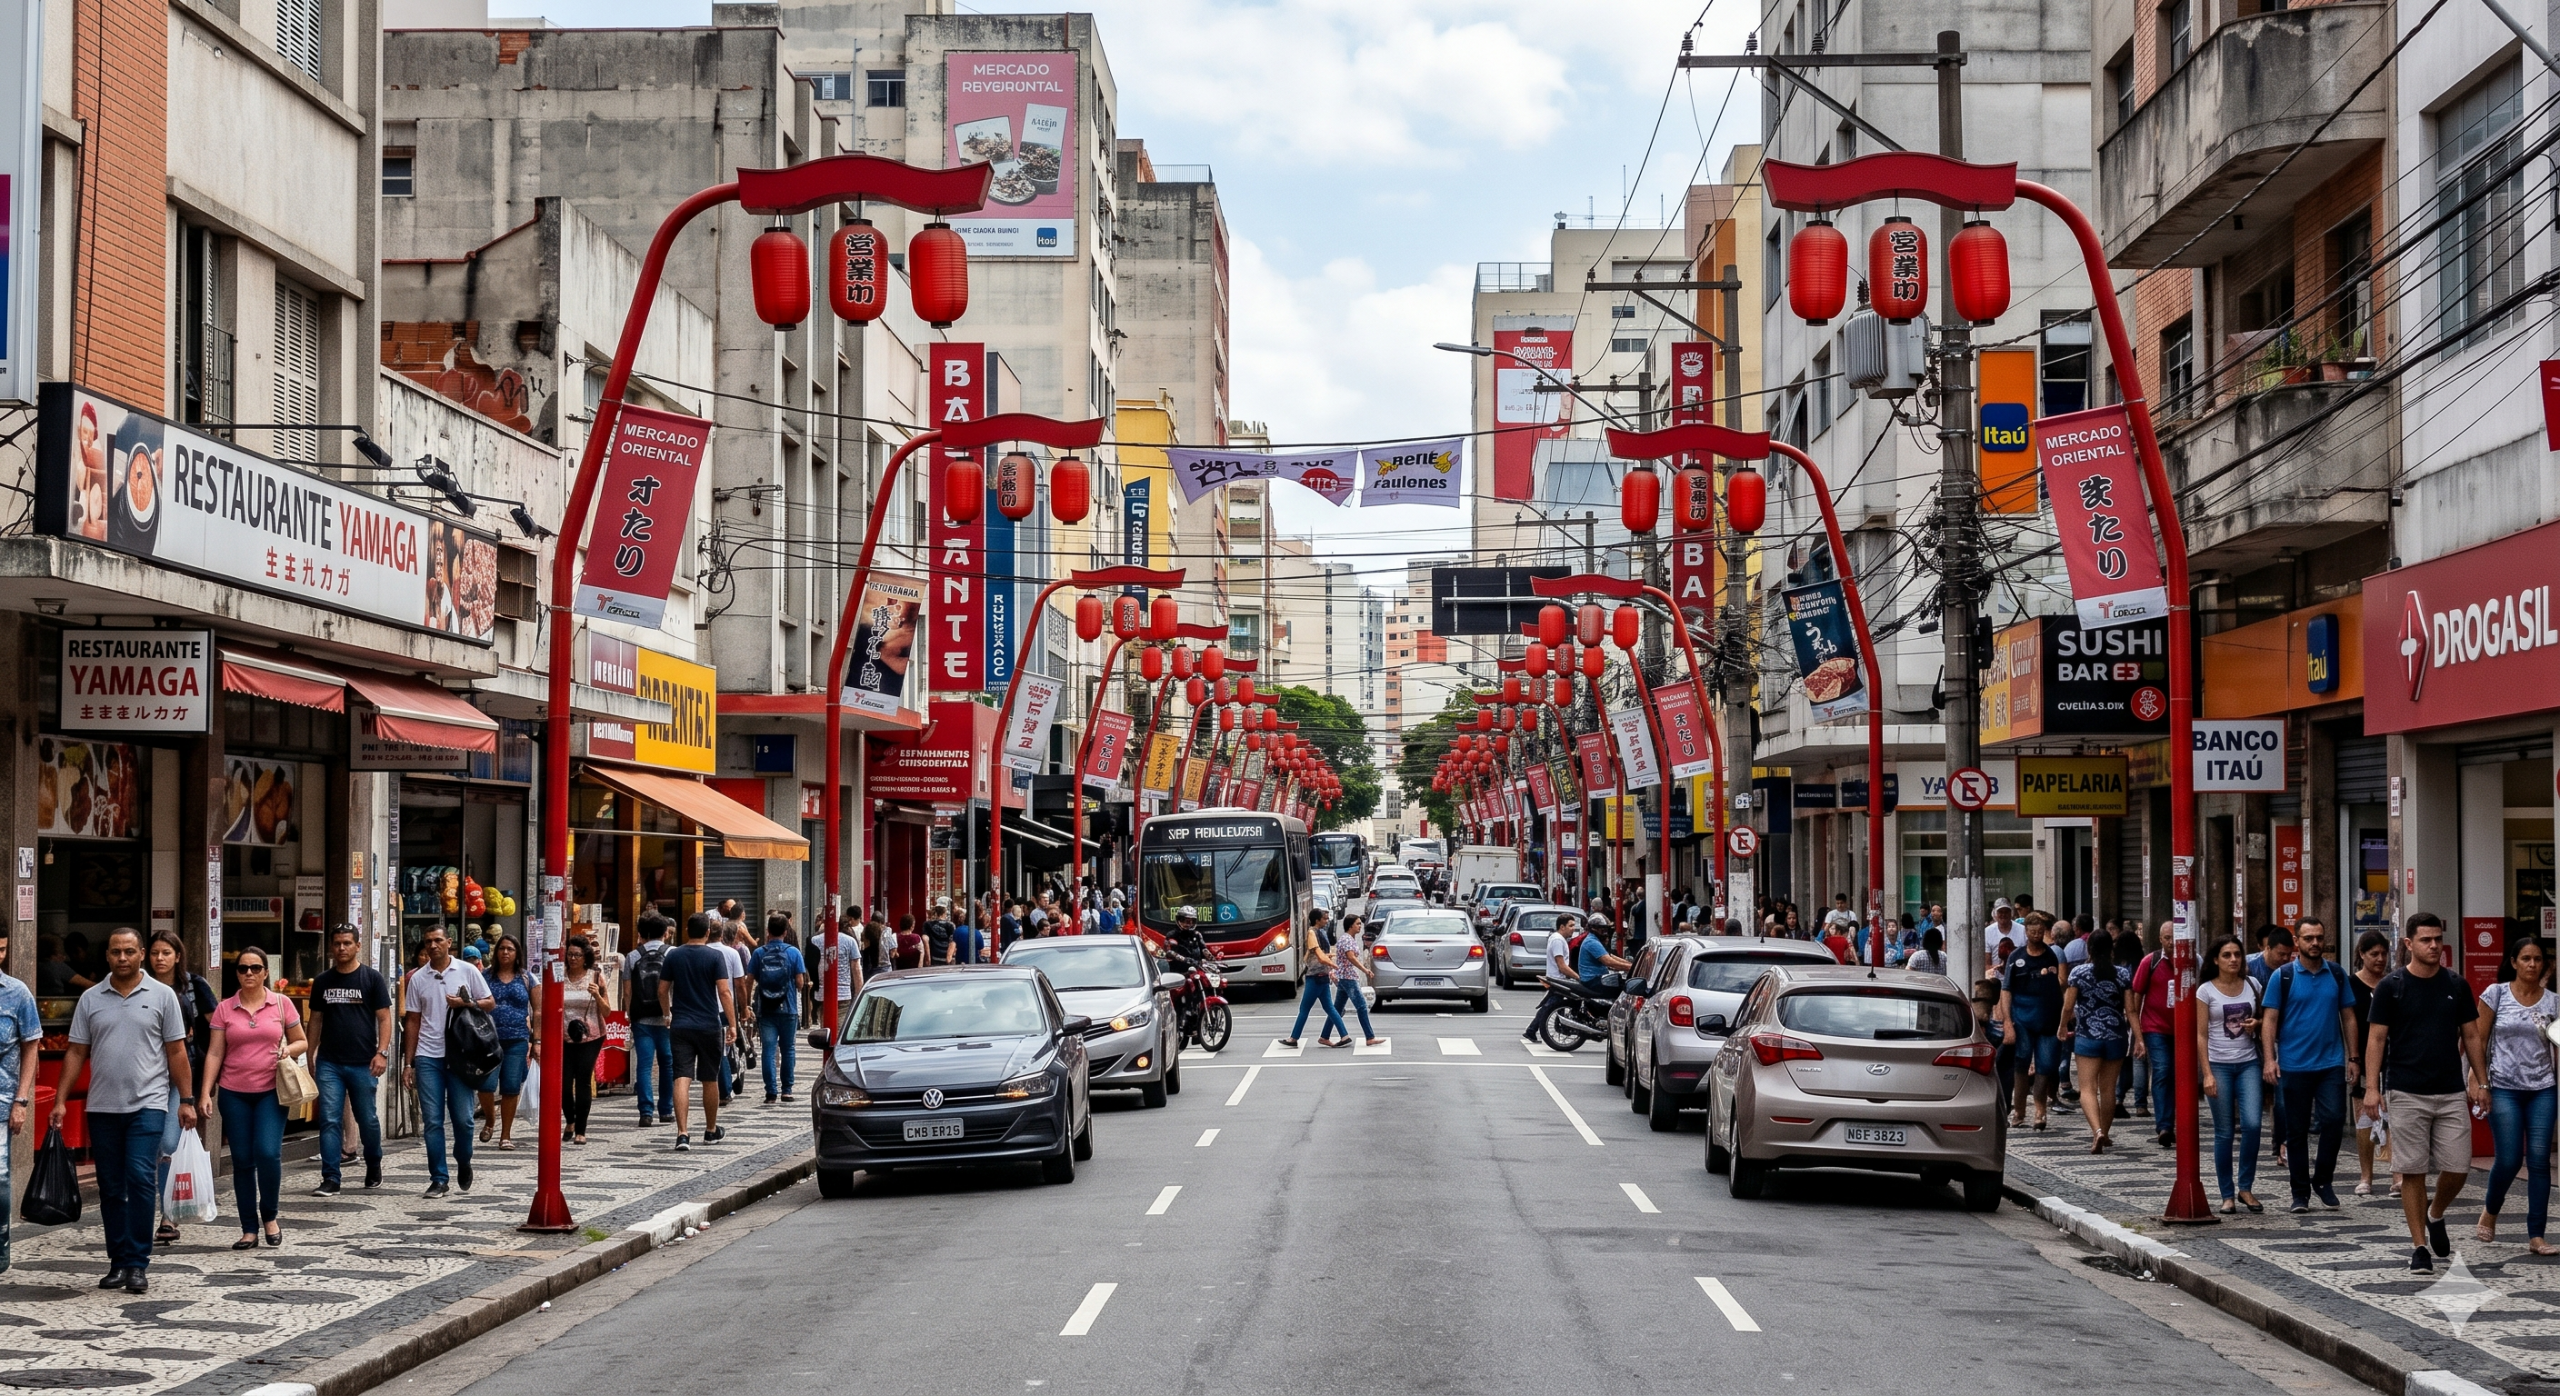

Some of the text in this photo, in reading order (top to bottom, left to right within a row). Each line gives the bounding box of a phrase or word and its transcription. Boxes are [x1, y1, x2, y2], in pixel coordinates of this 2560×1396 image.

[973, 64, 1050, 76] MERCADO
[624, 422, 698, 449] MERCADO
[1984, 426, 2026, 445] Itaú
[2045, 425, 2122, 450] MERCADO
[621, 441, 692, 467] ORIENTAL
[2051, 444, 2126, 467] ORIENTAL
[174, 444, 418, 576] RESTAURANTE YAMAGA
[2433, 585, 2559, 669] DROGASIL
[68, 639, 201, 659] RESTAURANTE
[2057, 629, 2163, 657] SUSHI
[69, 665, 200, 696] YAMAGA
[2058, 663, 2108, 681] BAR
[2193, 730, 2279, 752] BANCO
[2207, 754, 2263, 781] ITAÚ
[2023, 773, 2123, 793] PAPELARIA
[1873, 1130, 1904, 1143] 3823
